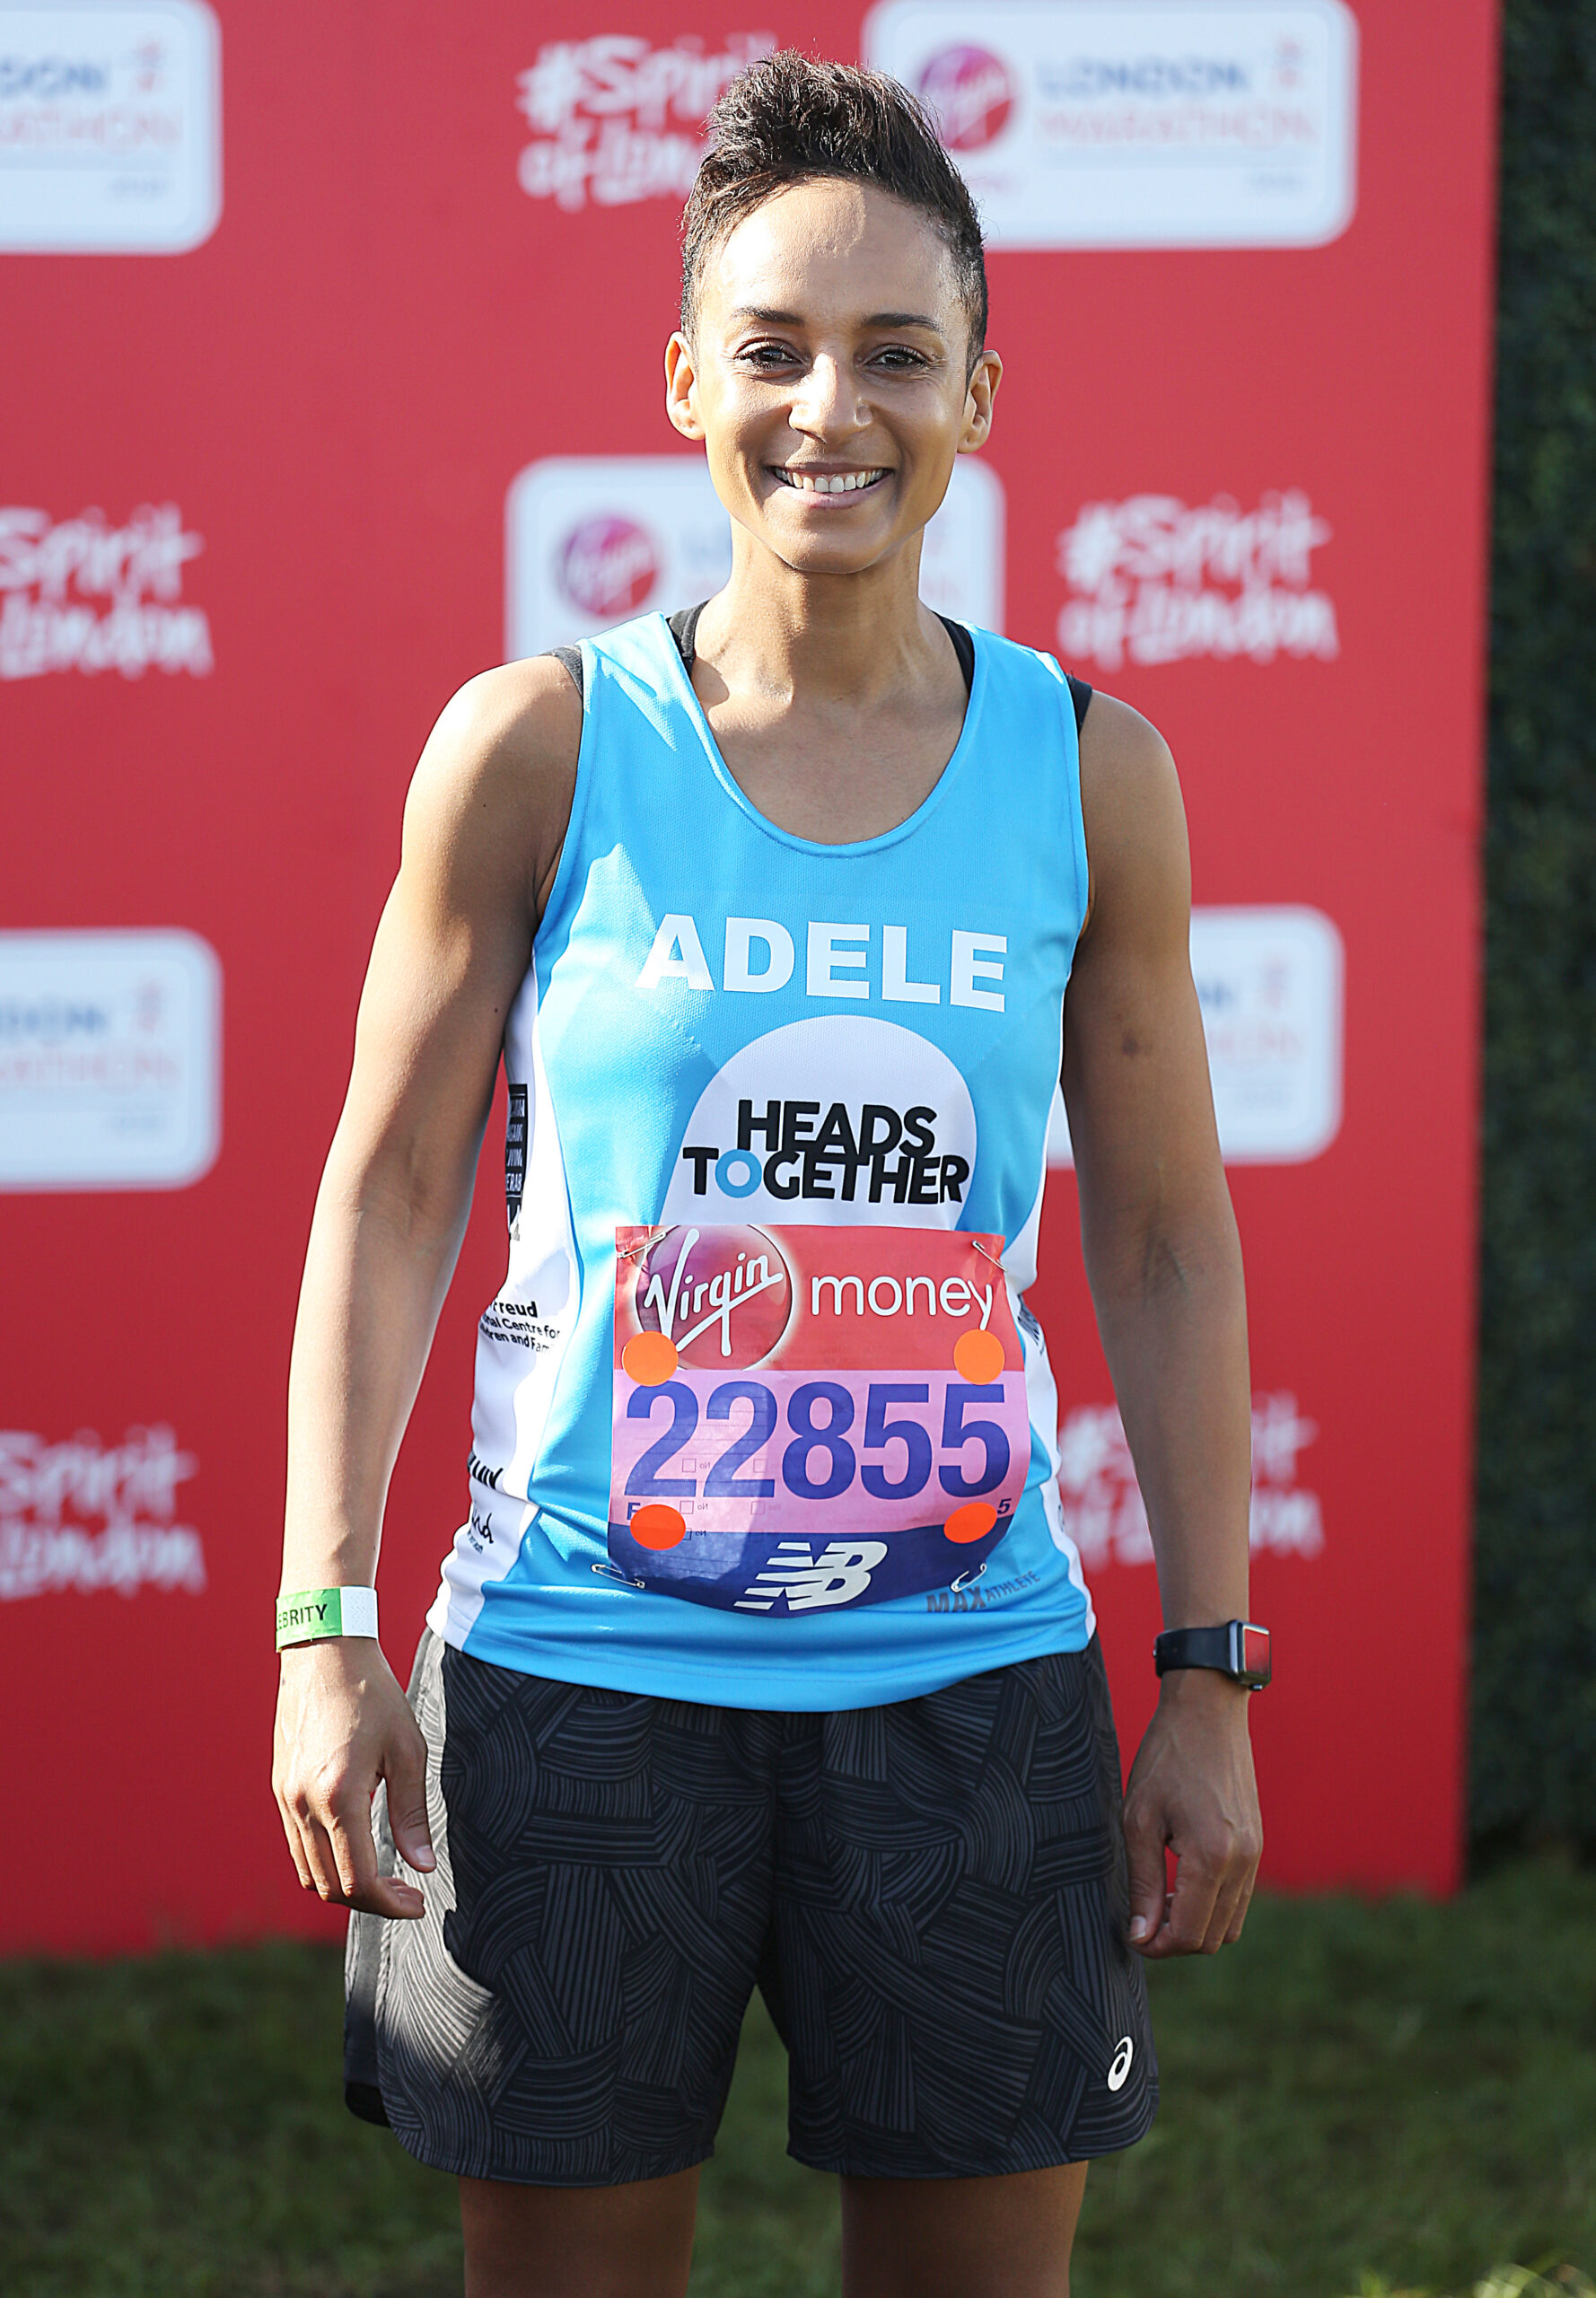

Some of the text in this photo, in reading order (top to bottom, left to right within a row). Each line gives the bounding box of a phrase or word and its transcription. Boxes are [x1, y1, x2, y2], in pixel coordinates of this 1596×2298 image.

[634, 914, 1007, 1013] ADELE
[737, 1100, 937, 1164] HEADS
[683, 1146, 969, 1205] TOGETHER
[644, 1227, 784, 1356] Virgin
[811, 1275, 994, 1330] money
[501, 1318, 543, 1336] Centre
[509, 1334, 531, 1348] and
[623, 1381, 1011, 1501] 22855
[278, 1603, 328, 1630] EBRITY
